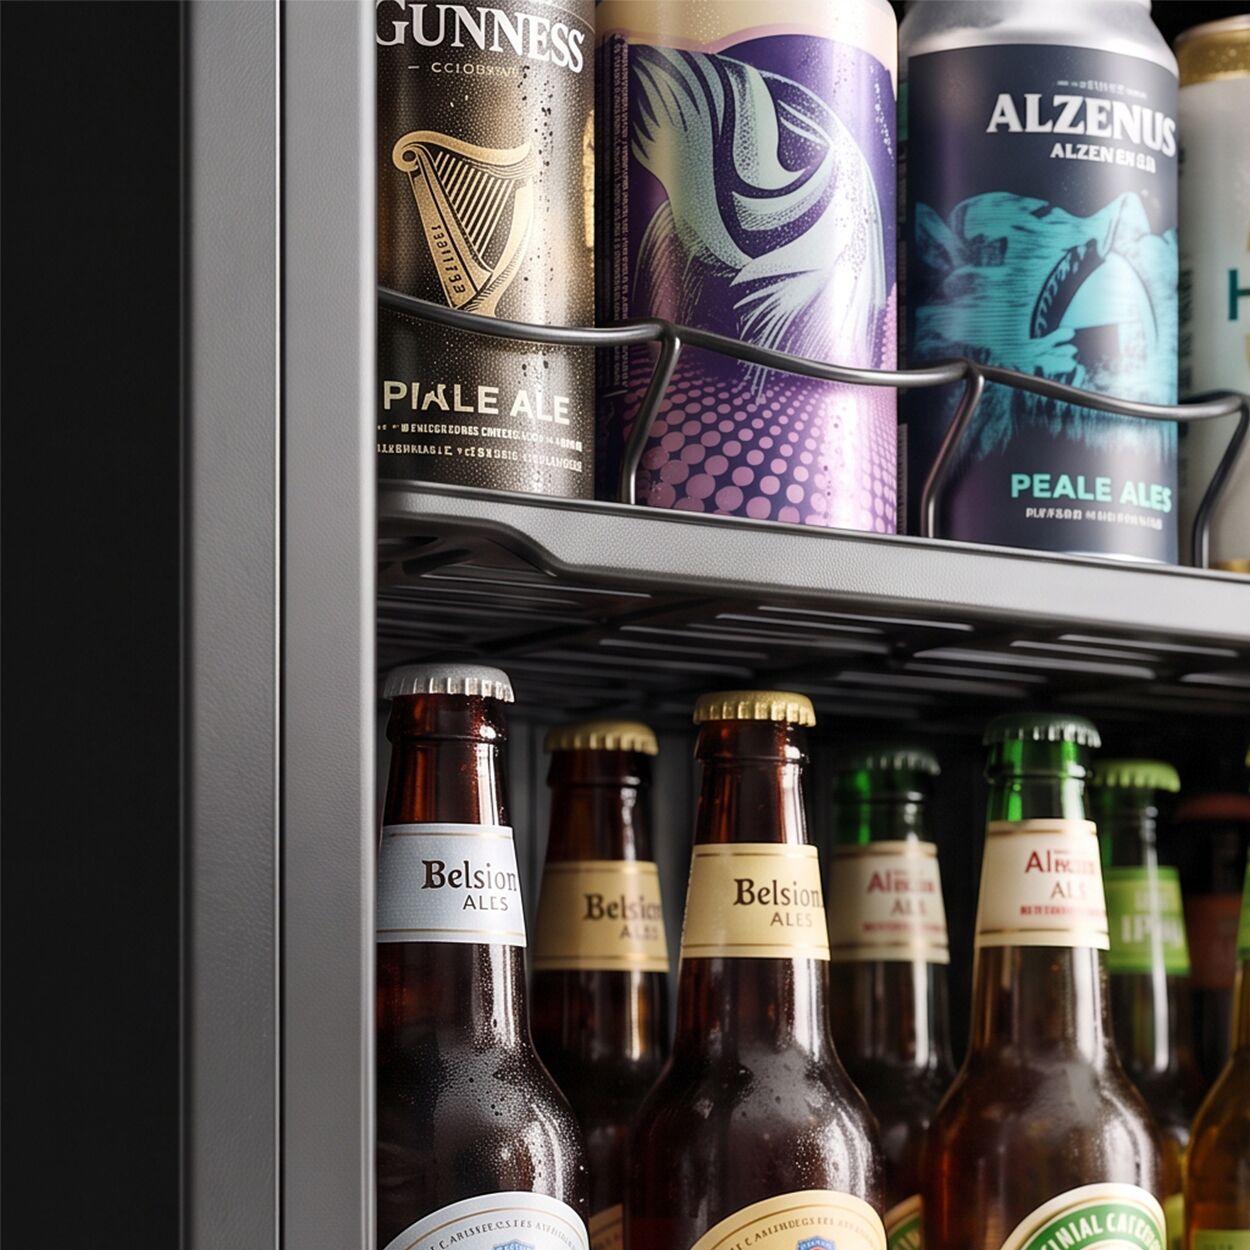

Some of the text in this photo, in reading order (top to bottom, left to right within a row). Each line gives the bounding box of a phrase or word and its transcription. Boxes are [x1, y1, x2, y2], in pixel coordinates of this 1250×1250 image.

[986, 93, 1177, 158] ALZENUS
[510, 389, 570, 426] ALE
[1011, 473, 1173, 514] PEALE ALES
[421, 859, 518, 892] Belsion
[462, 894, 509, 912] ALES
[769, 911, 813, 928] ALES
